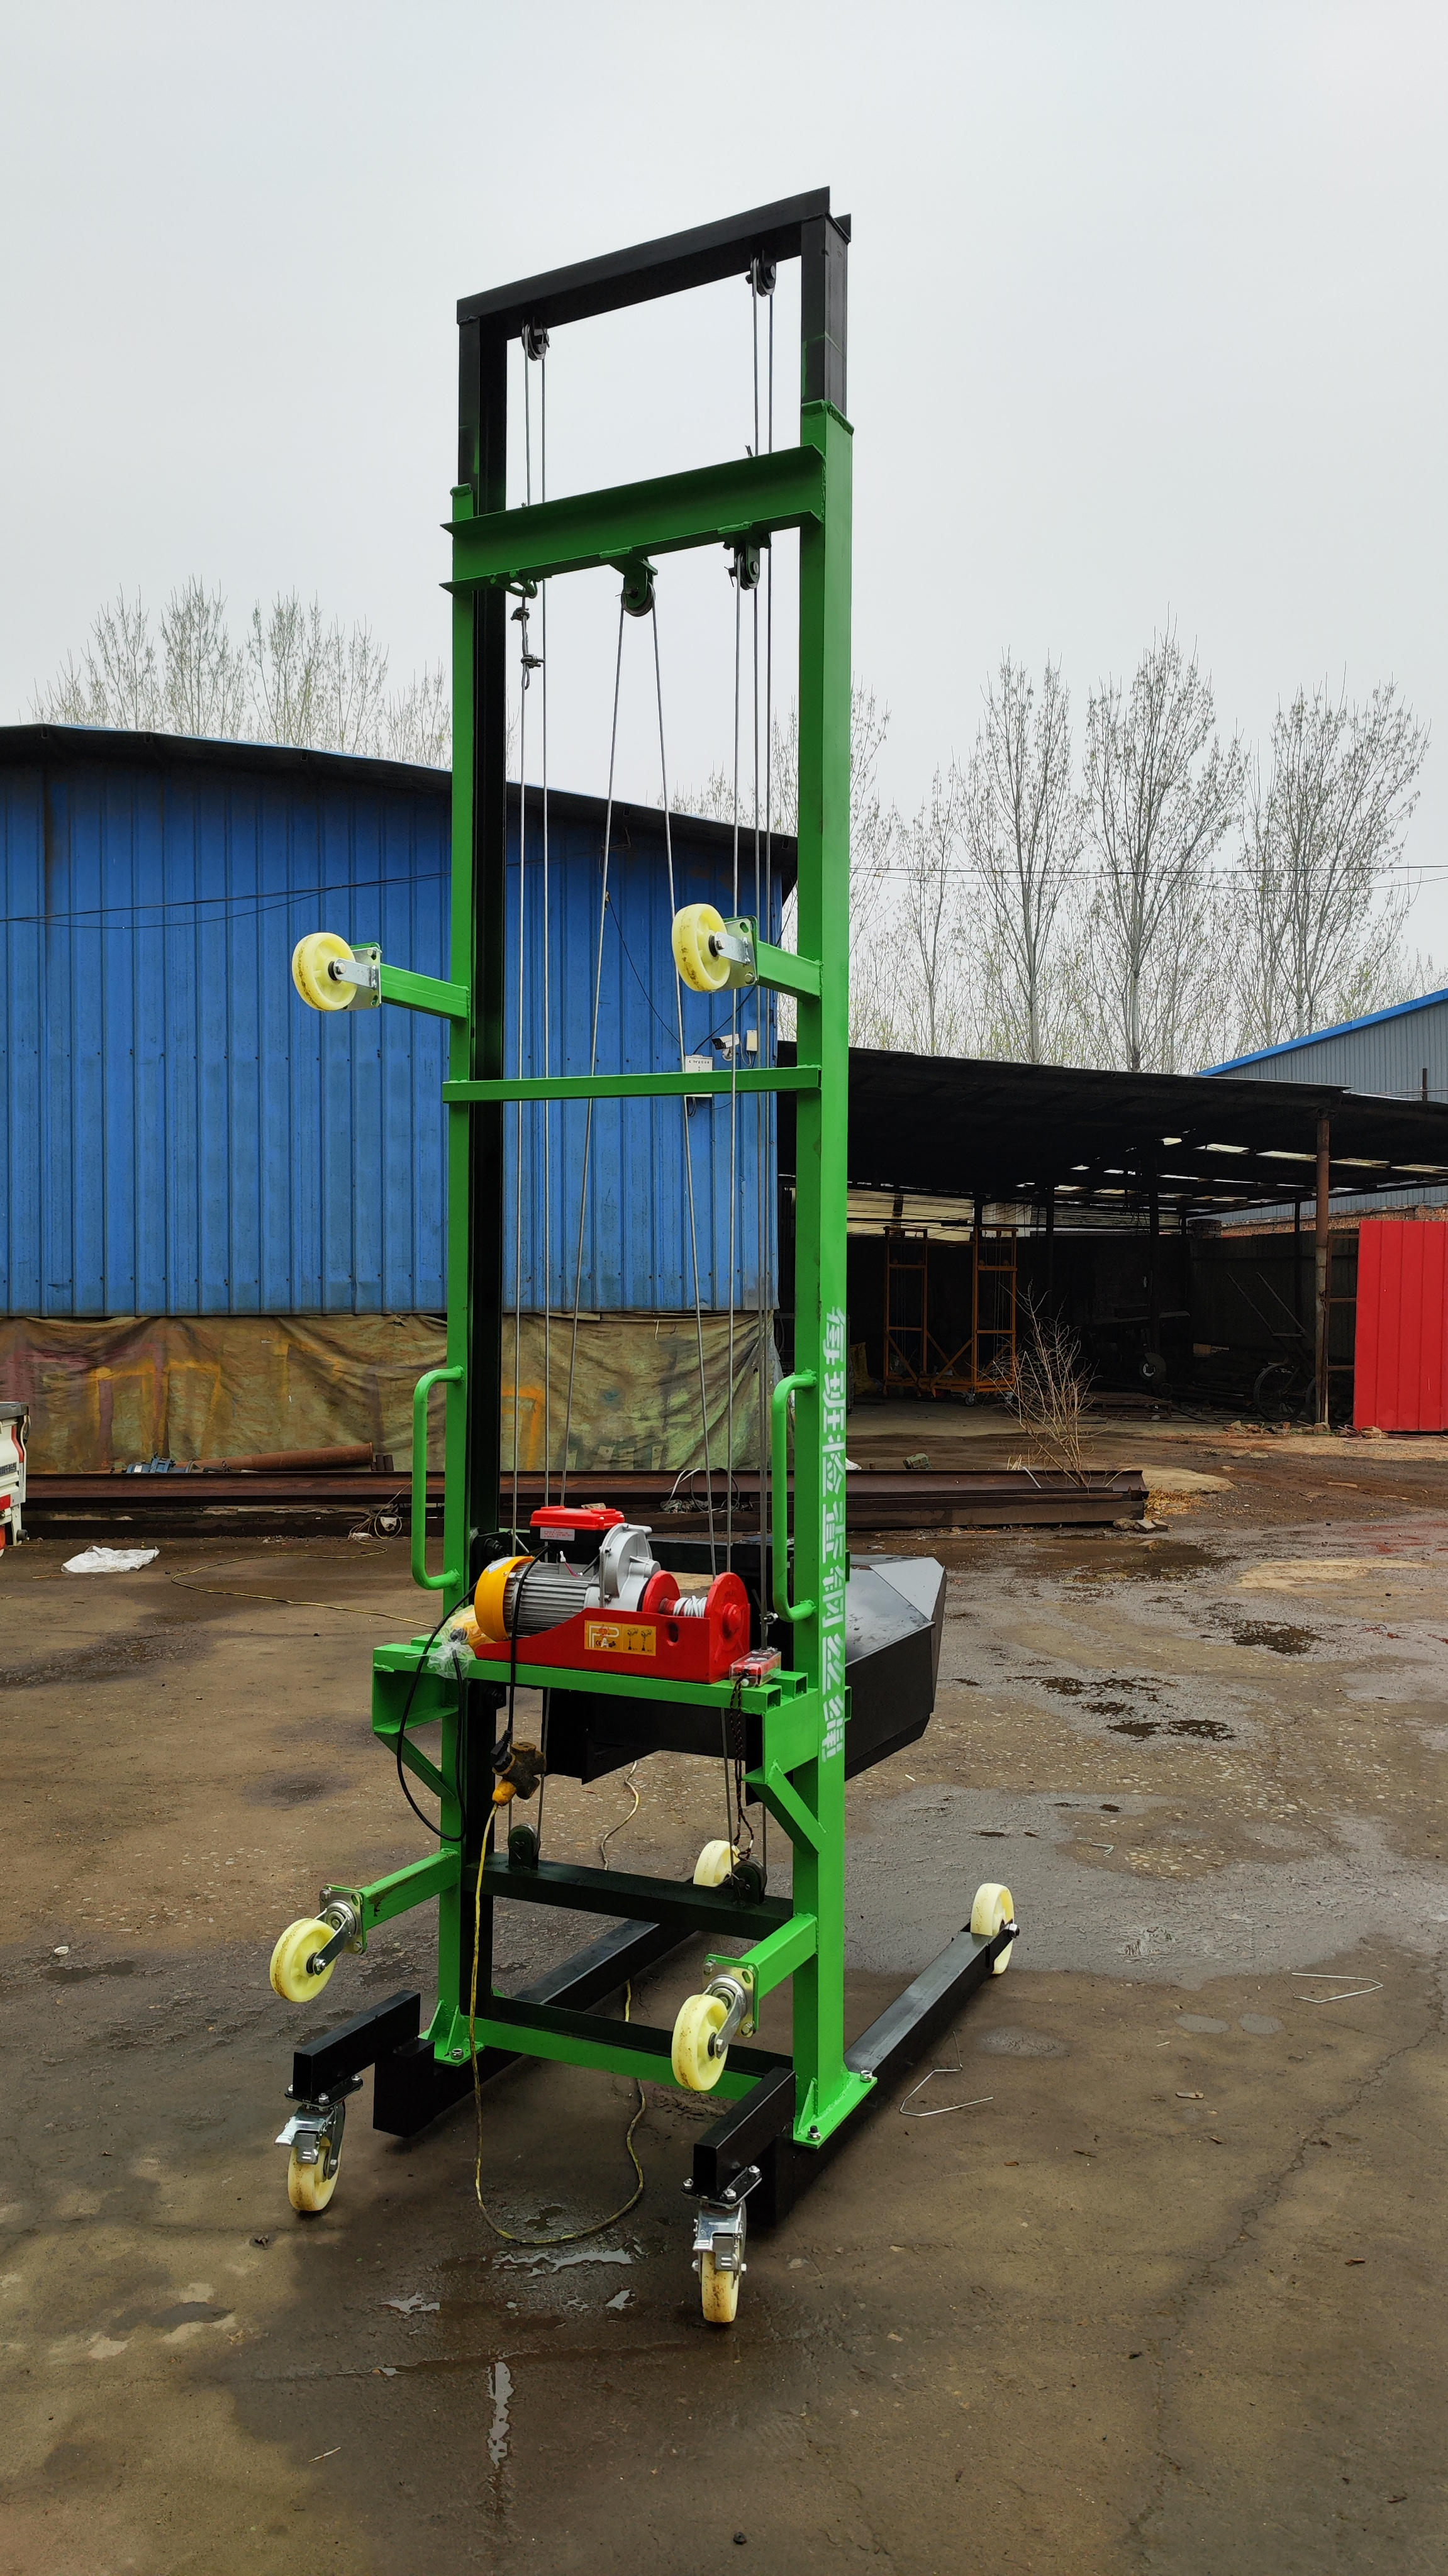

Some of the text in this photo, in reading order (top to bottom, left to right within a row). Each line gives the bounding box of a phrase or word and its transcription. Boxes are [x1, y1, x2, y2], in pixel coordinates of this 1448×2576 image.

[822, 1306, 845, 1762] 每班检查钢丝绳
